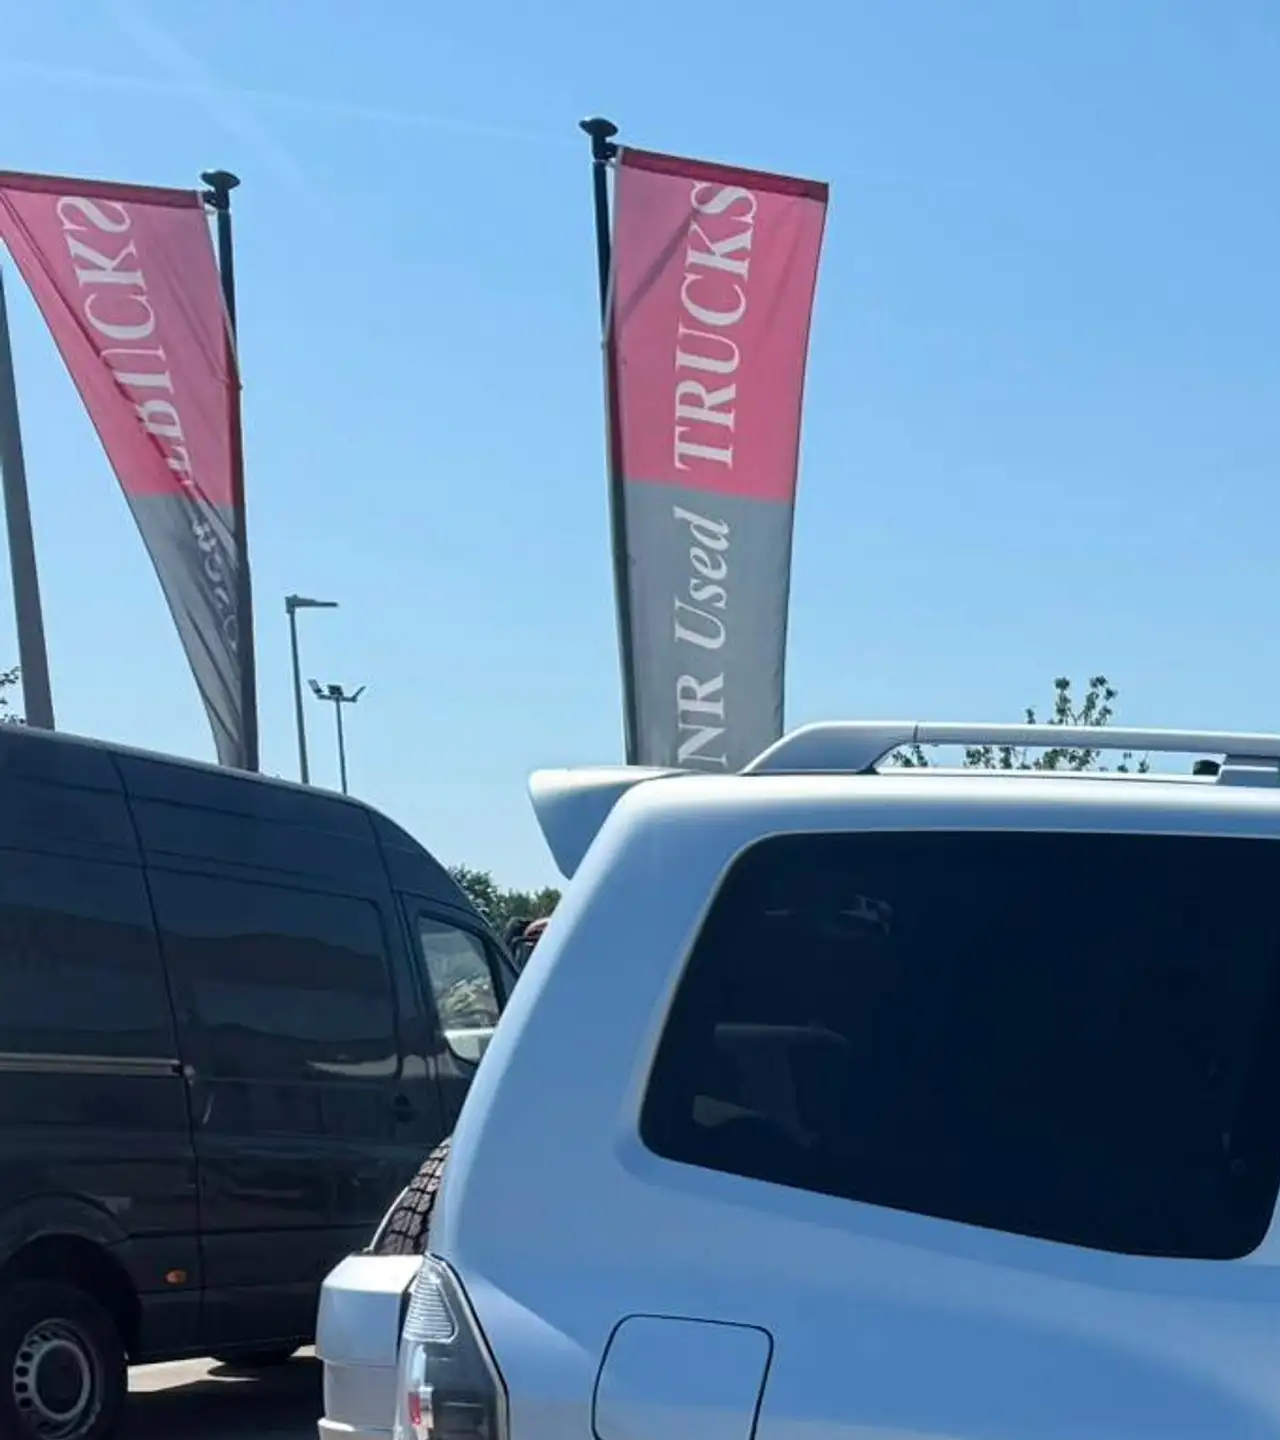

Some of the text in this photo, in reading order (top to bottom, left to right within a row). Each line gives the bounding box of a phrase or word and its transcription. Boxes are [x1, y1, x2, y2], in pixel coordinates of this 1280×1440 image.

[673, 182, 757, 768] NR Used TRUCKS
